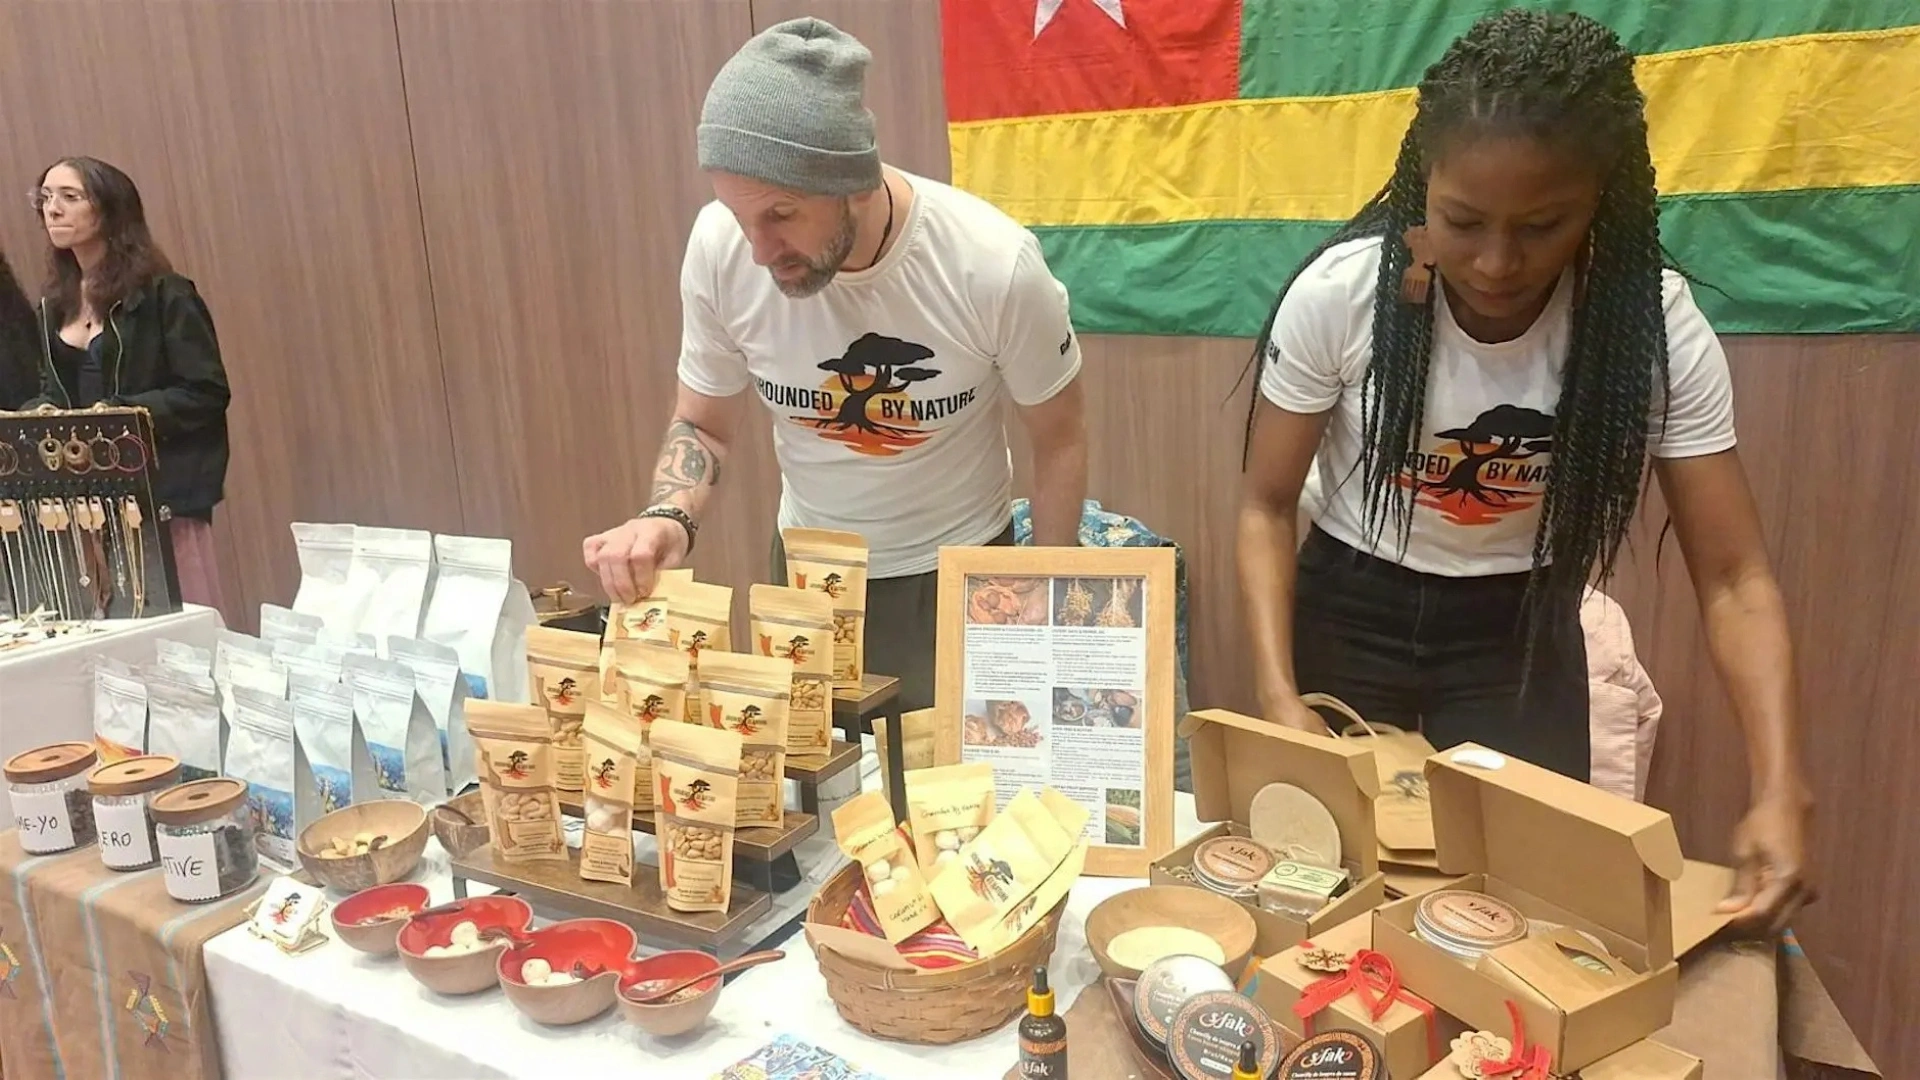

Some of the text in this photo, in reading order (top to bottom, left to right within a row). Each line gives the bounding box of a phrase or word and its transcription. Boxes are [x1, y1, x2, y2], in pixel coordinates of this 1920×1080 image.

[755, 377, 977, 421] ROUNDED BY NATURE
[1486, 461, 1514, 482] BY
